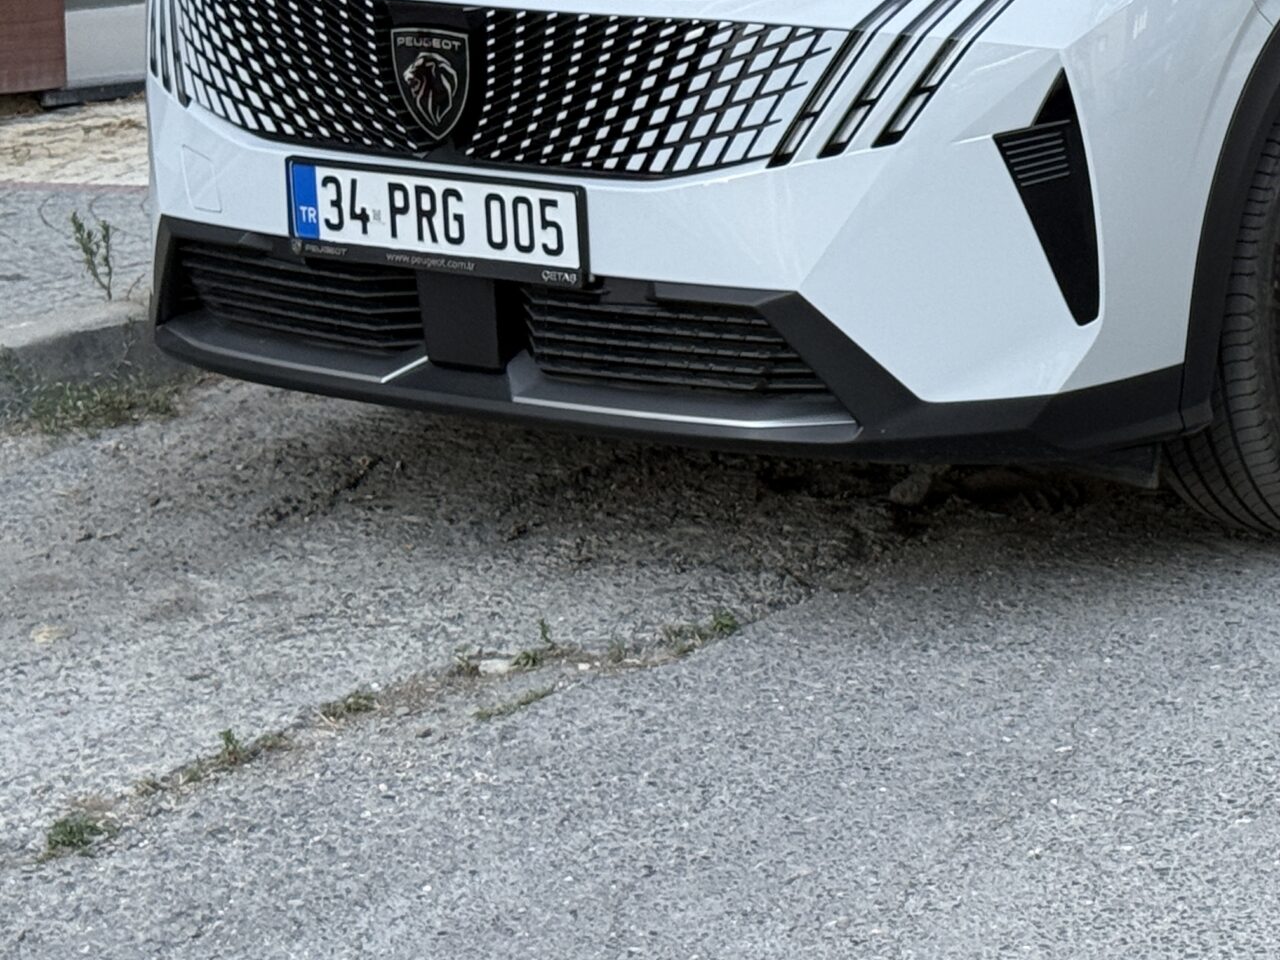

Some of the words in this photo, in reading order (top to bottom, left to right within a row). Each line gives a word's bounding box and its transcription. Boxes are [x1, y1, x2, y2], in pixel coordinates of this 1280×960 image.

[397, 35, 462, 52] PEUGEOT
[300, 206, 317, 224] TR
[321, 175, 370, 235] 34
[387, 182, 466, 245] PRG
[485, 193, 564, 257] 005
